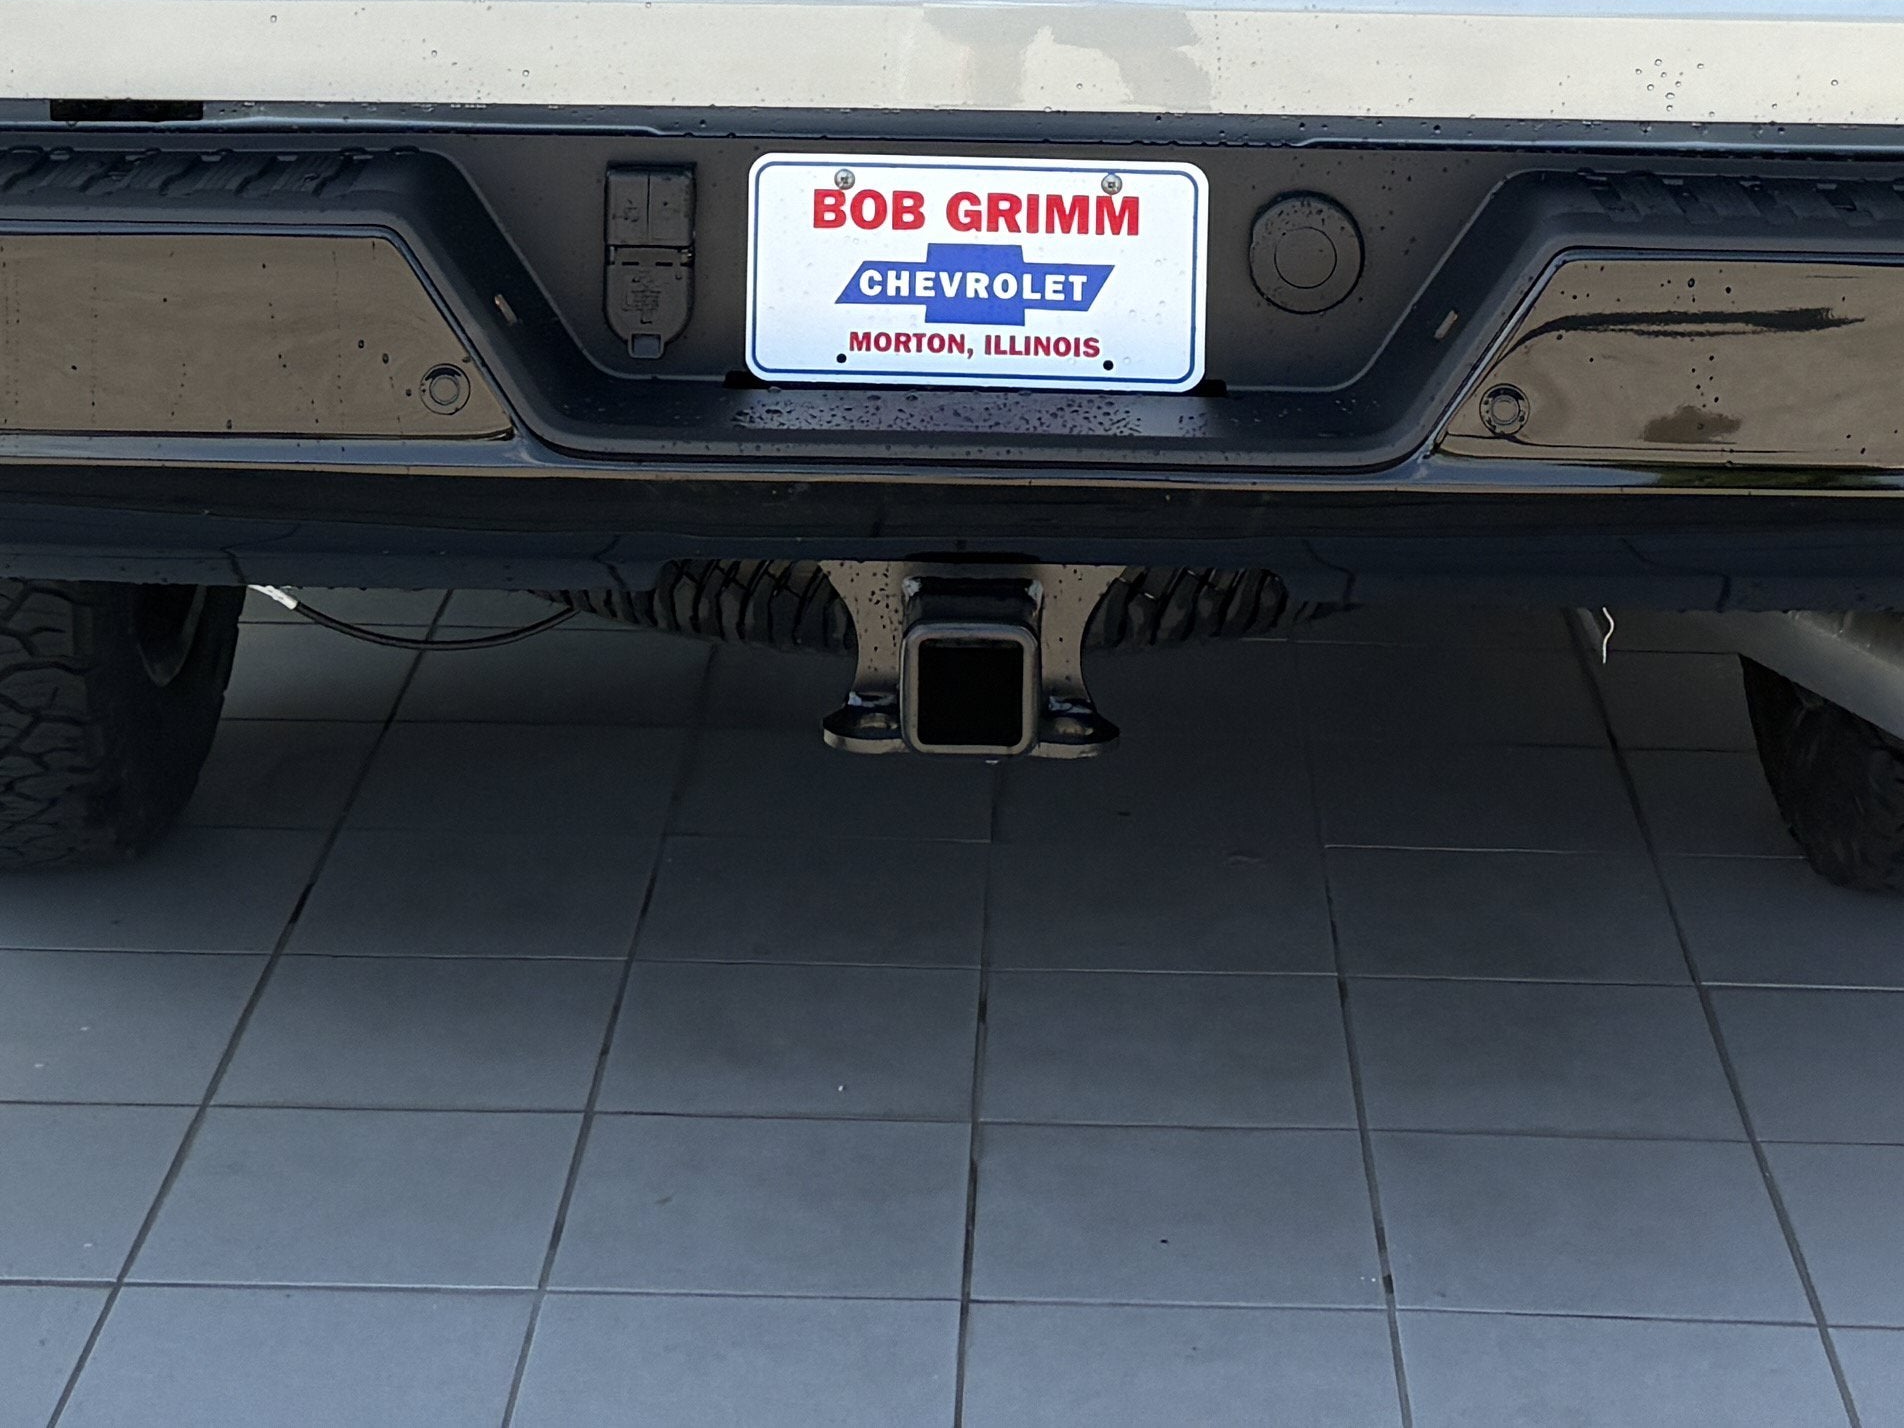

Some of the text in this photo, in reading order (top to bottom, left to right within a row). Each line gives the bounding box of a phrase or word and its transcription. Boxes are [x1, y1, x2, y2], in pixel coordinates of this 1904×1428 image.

[812, 188, 1140, 236] BOB GRIMM
[858, 269, 1088, 302] CHEVROLET
[848, 331, 1101, 360] MORTON, ILLINOIS
